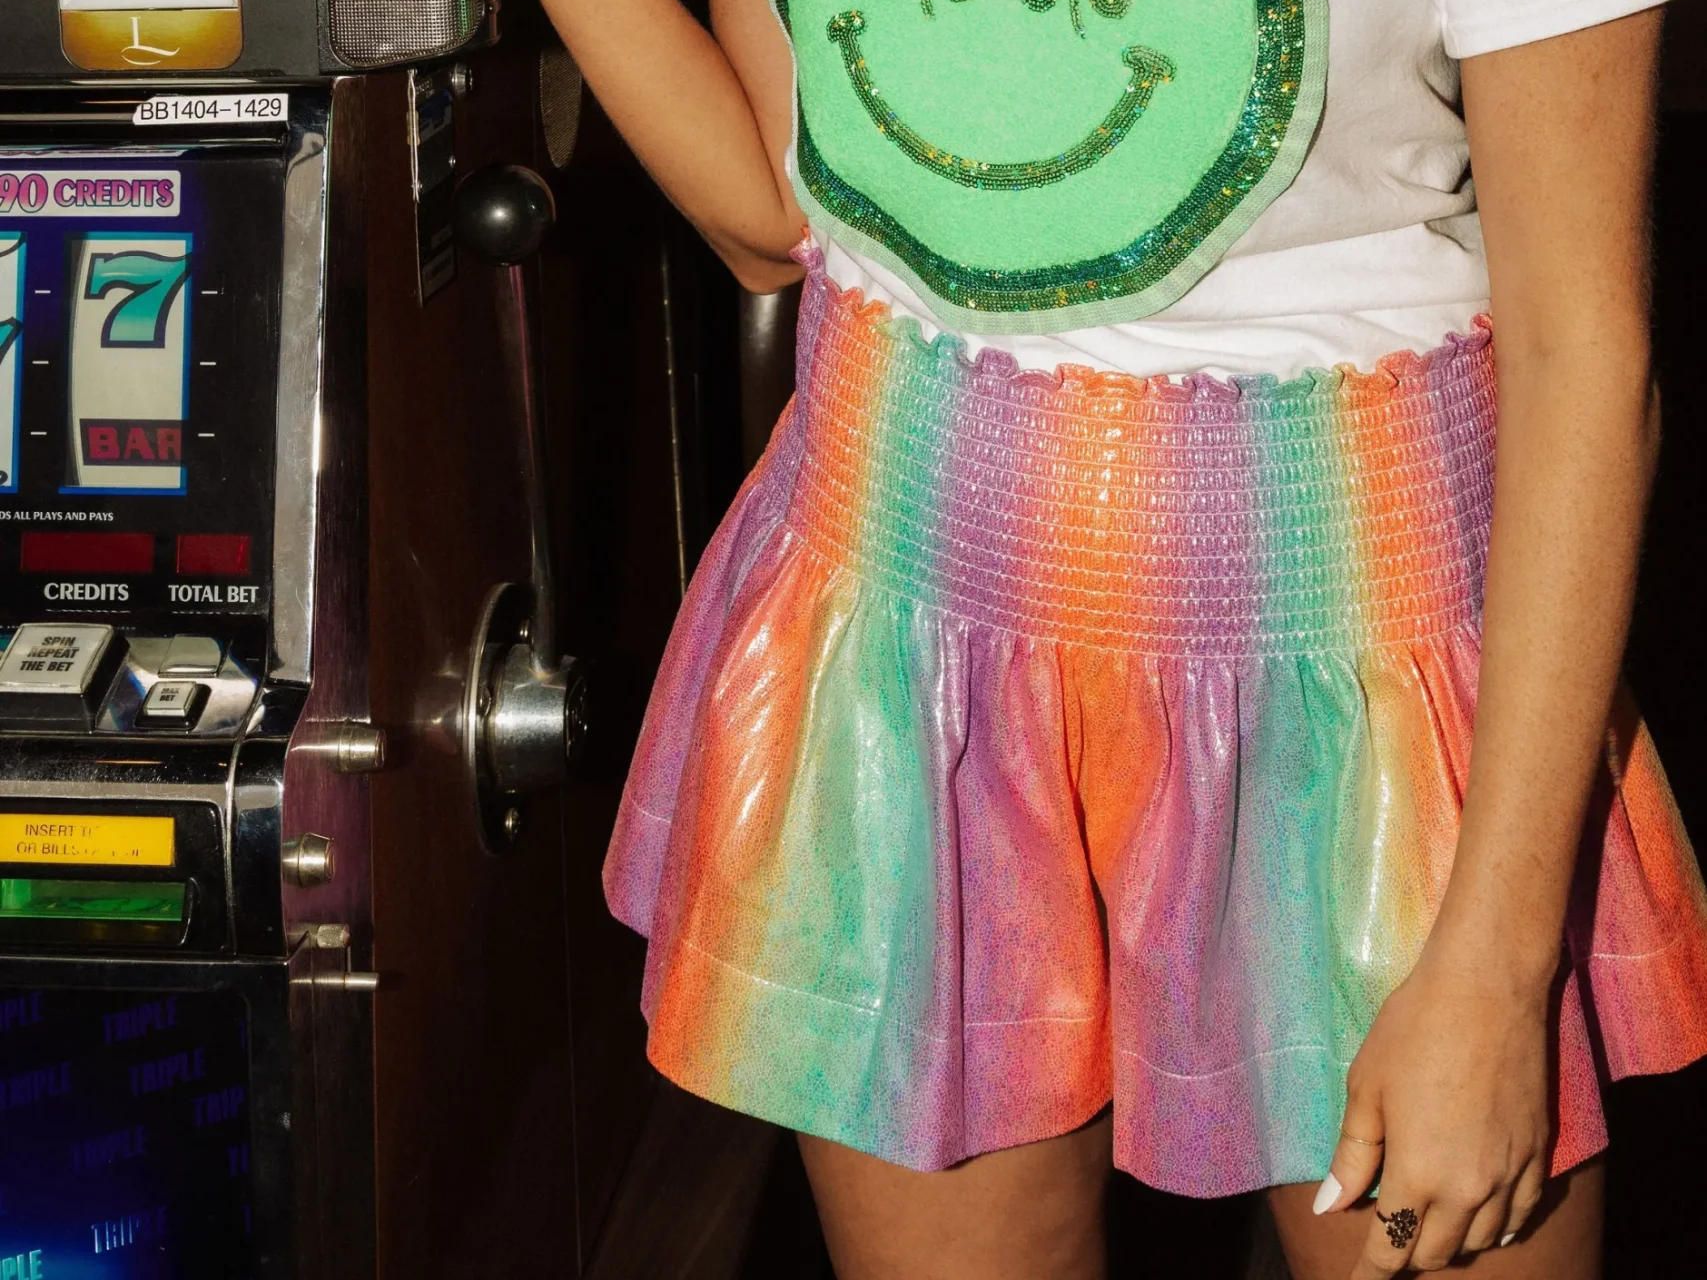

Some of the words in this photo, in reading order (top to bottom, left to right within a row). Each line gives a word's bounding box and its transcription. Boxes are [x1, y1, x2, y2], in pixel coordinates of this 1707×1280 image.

[140, 98, 282, 120] BB1404-1429
[53, 178, 174, 207] CREDITS
[84, 250, 192, 348] 7
[89, 426, 182, 461] BAR
[13, 511, 30, 520] ALL
[33, 511, 63, 521] PLAYS
[64, 511, 87, 521] AND
[89, 512, 114, 521] PAYS
[43, 582, 130, 601] CREDITS
[168, 584, 223, 602] TOTAL
[227, 585, 260, 603] BET
[41, 636, 76, 647] SPIN
[27, 648, 80, 658] REPEAT
[20, 661, 45, 671] THE
[46, 661, 73, 672] BET
[25, 824, 75, 837] INSERT
